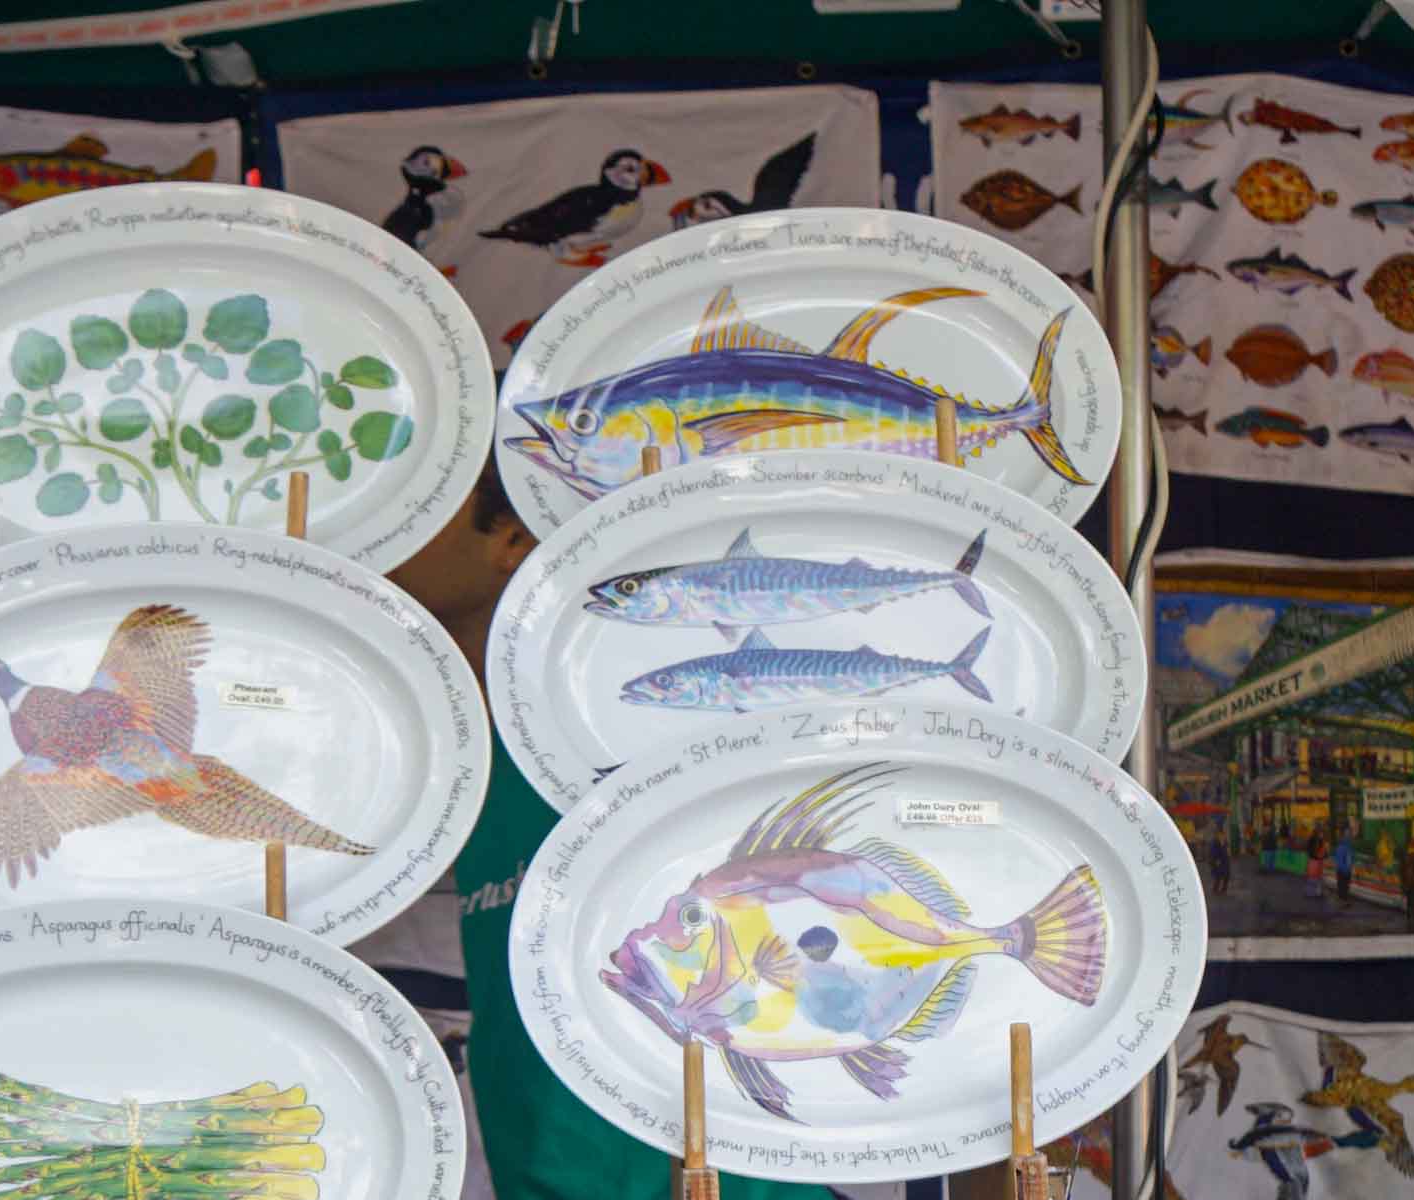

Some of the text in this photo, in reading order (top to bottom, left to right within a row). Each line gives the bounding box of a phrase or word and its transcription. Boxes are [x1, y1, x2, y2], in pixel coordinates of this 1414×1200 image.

[1231, 671, 1302, 714] MARKET
[923, 711, 1005, 758] John Dory
[209, 916, 286, 962] Asparagus
